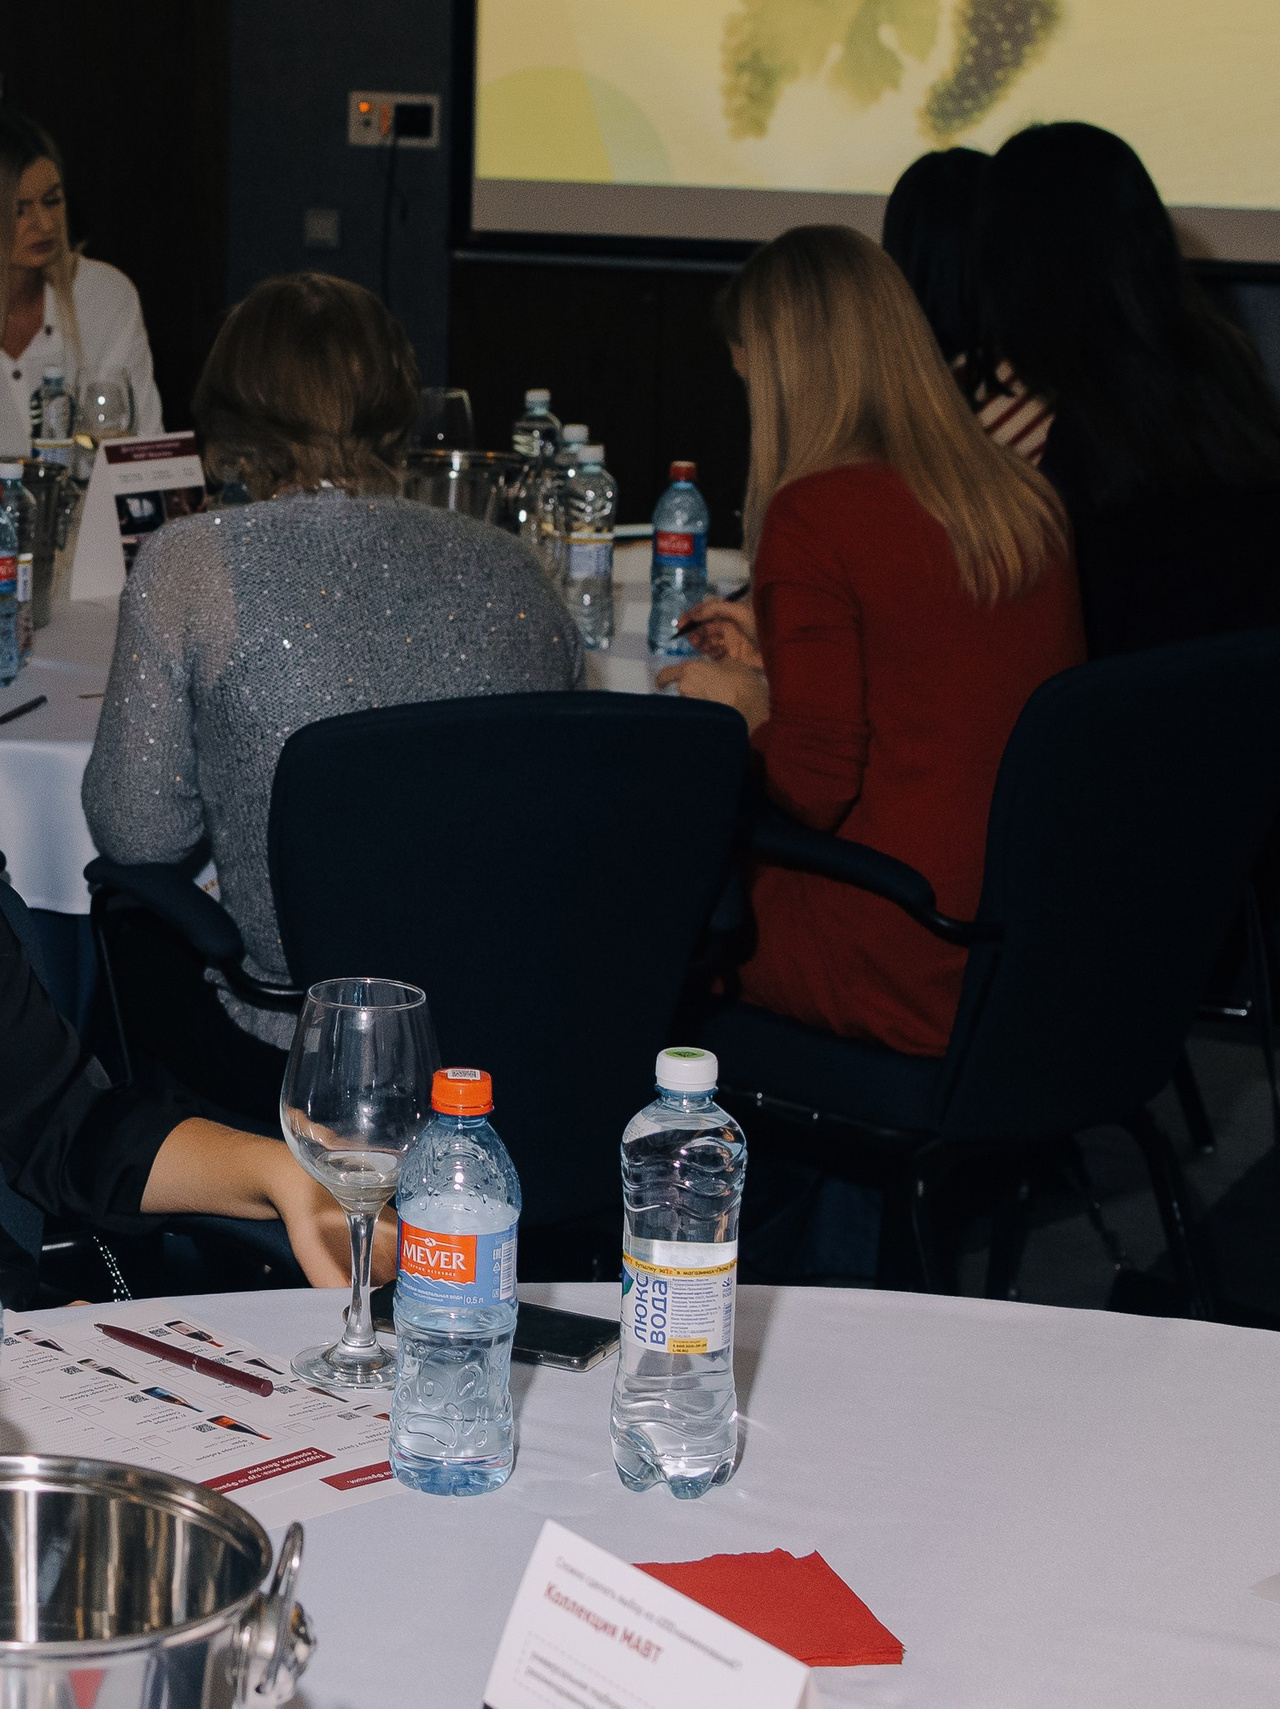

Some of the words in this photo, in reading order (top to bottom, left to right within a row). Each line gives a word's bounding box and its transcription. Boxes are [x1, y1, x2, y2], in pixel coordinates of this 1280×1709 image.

[403, 1240, 467, 1270] MEVER
[544, 1581, 620, 1638] Коллекция
[620, 1624, 664, 1666] МАВТ
